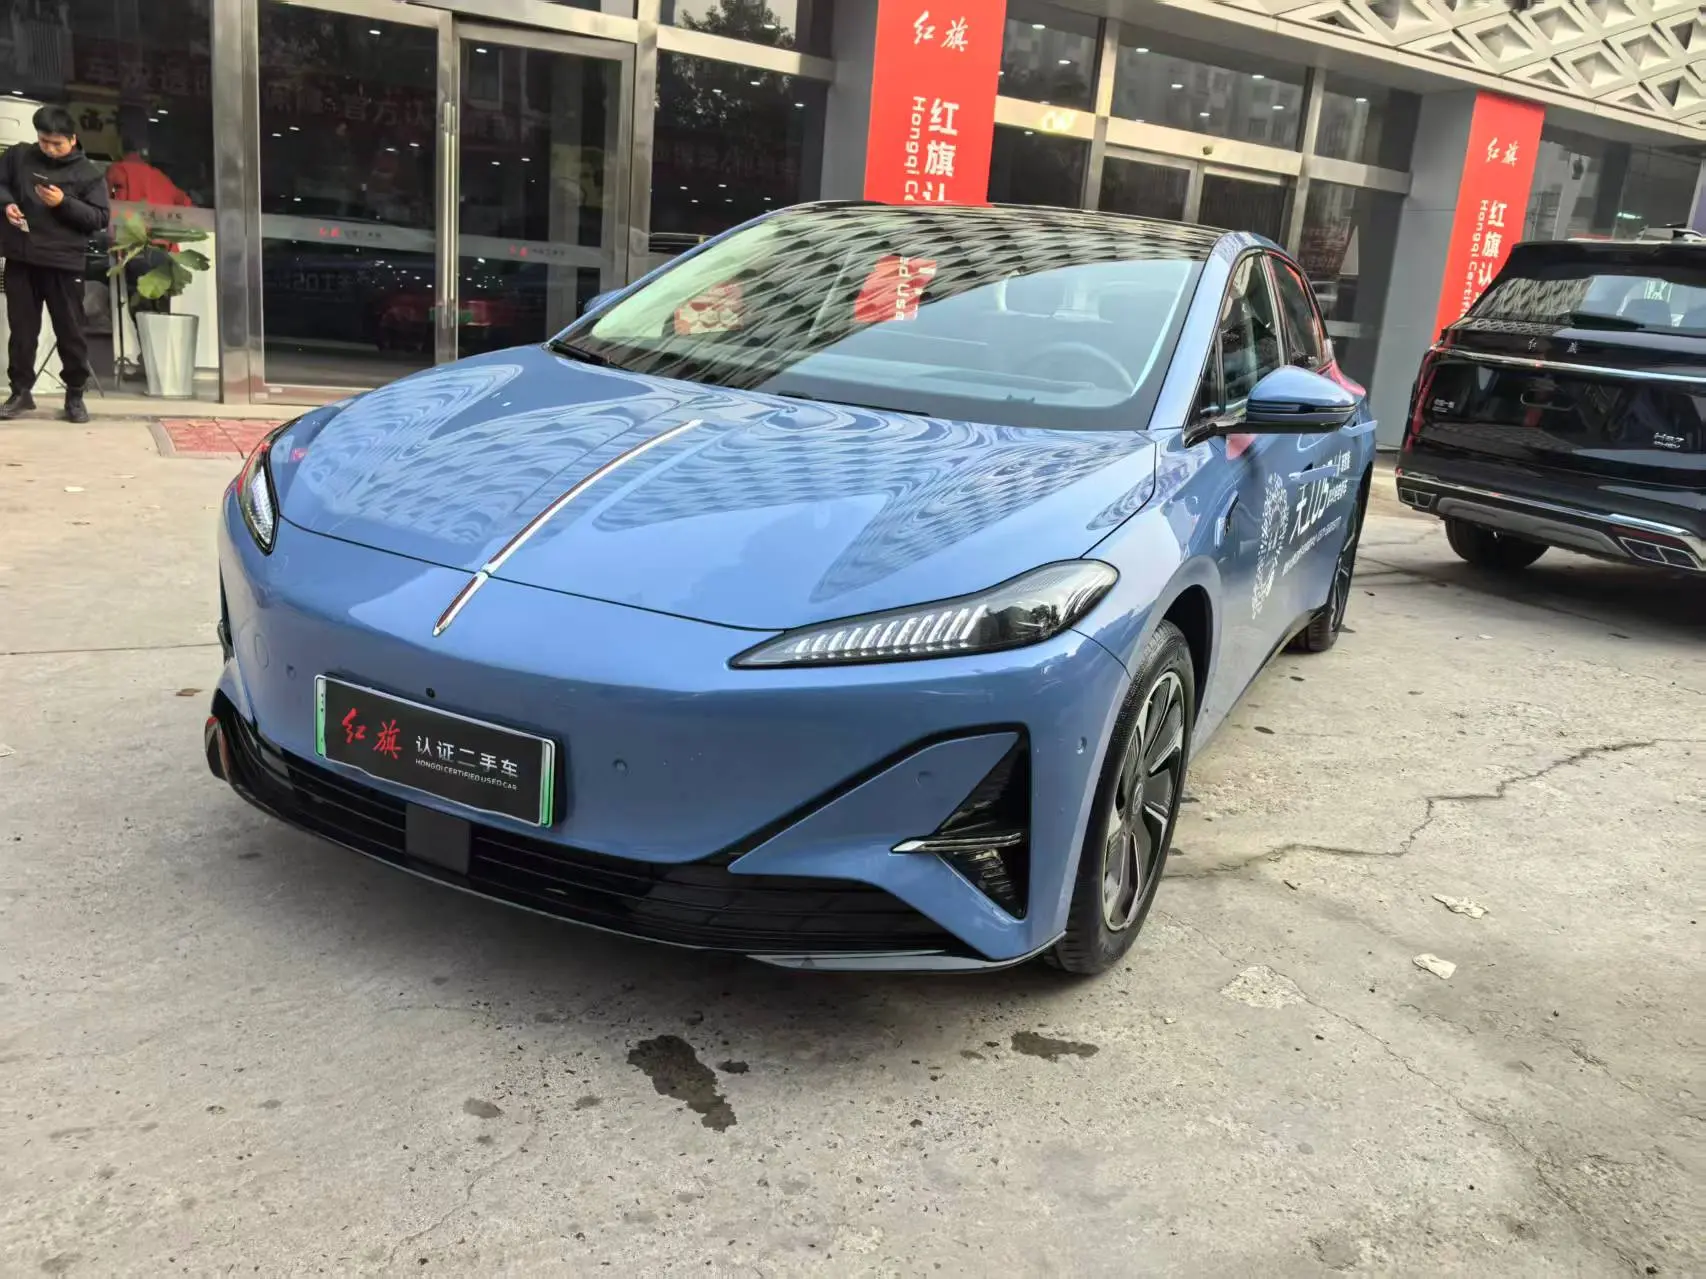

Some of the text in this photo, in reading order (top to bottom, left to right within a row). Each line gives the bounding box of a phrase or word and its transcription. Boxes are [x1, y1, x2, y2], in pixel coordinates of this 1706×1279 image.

[913, 10, 969, 52] 红旗
[903, 96, 927, 175] Hongqi
[922, 98, 959, 202] 红旗认
[1485, 136, 1520, 168] 红旗
[1470, 199, 1489, 258] Hongqi
[1473, 199, 1508, 303] 红旗认
[342, 707, 519, 778] 红旗 认证二手车
[443, 766, 481, 782] CERTIFIED
[480, 776, 502, 787] USED
[502, 781, 518, 791] CAR
